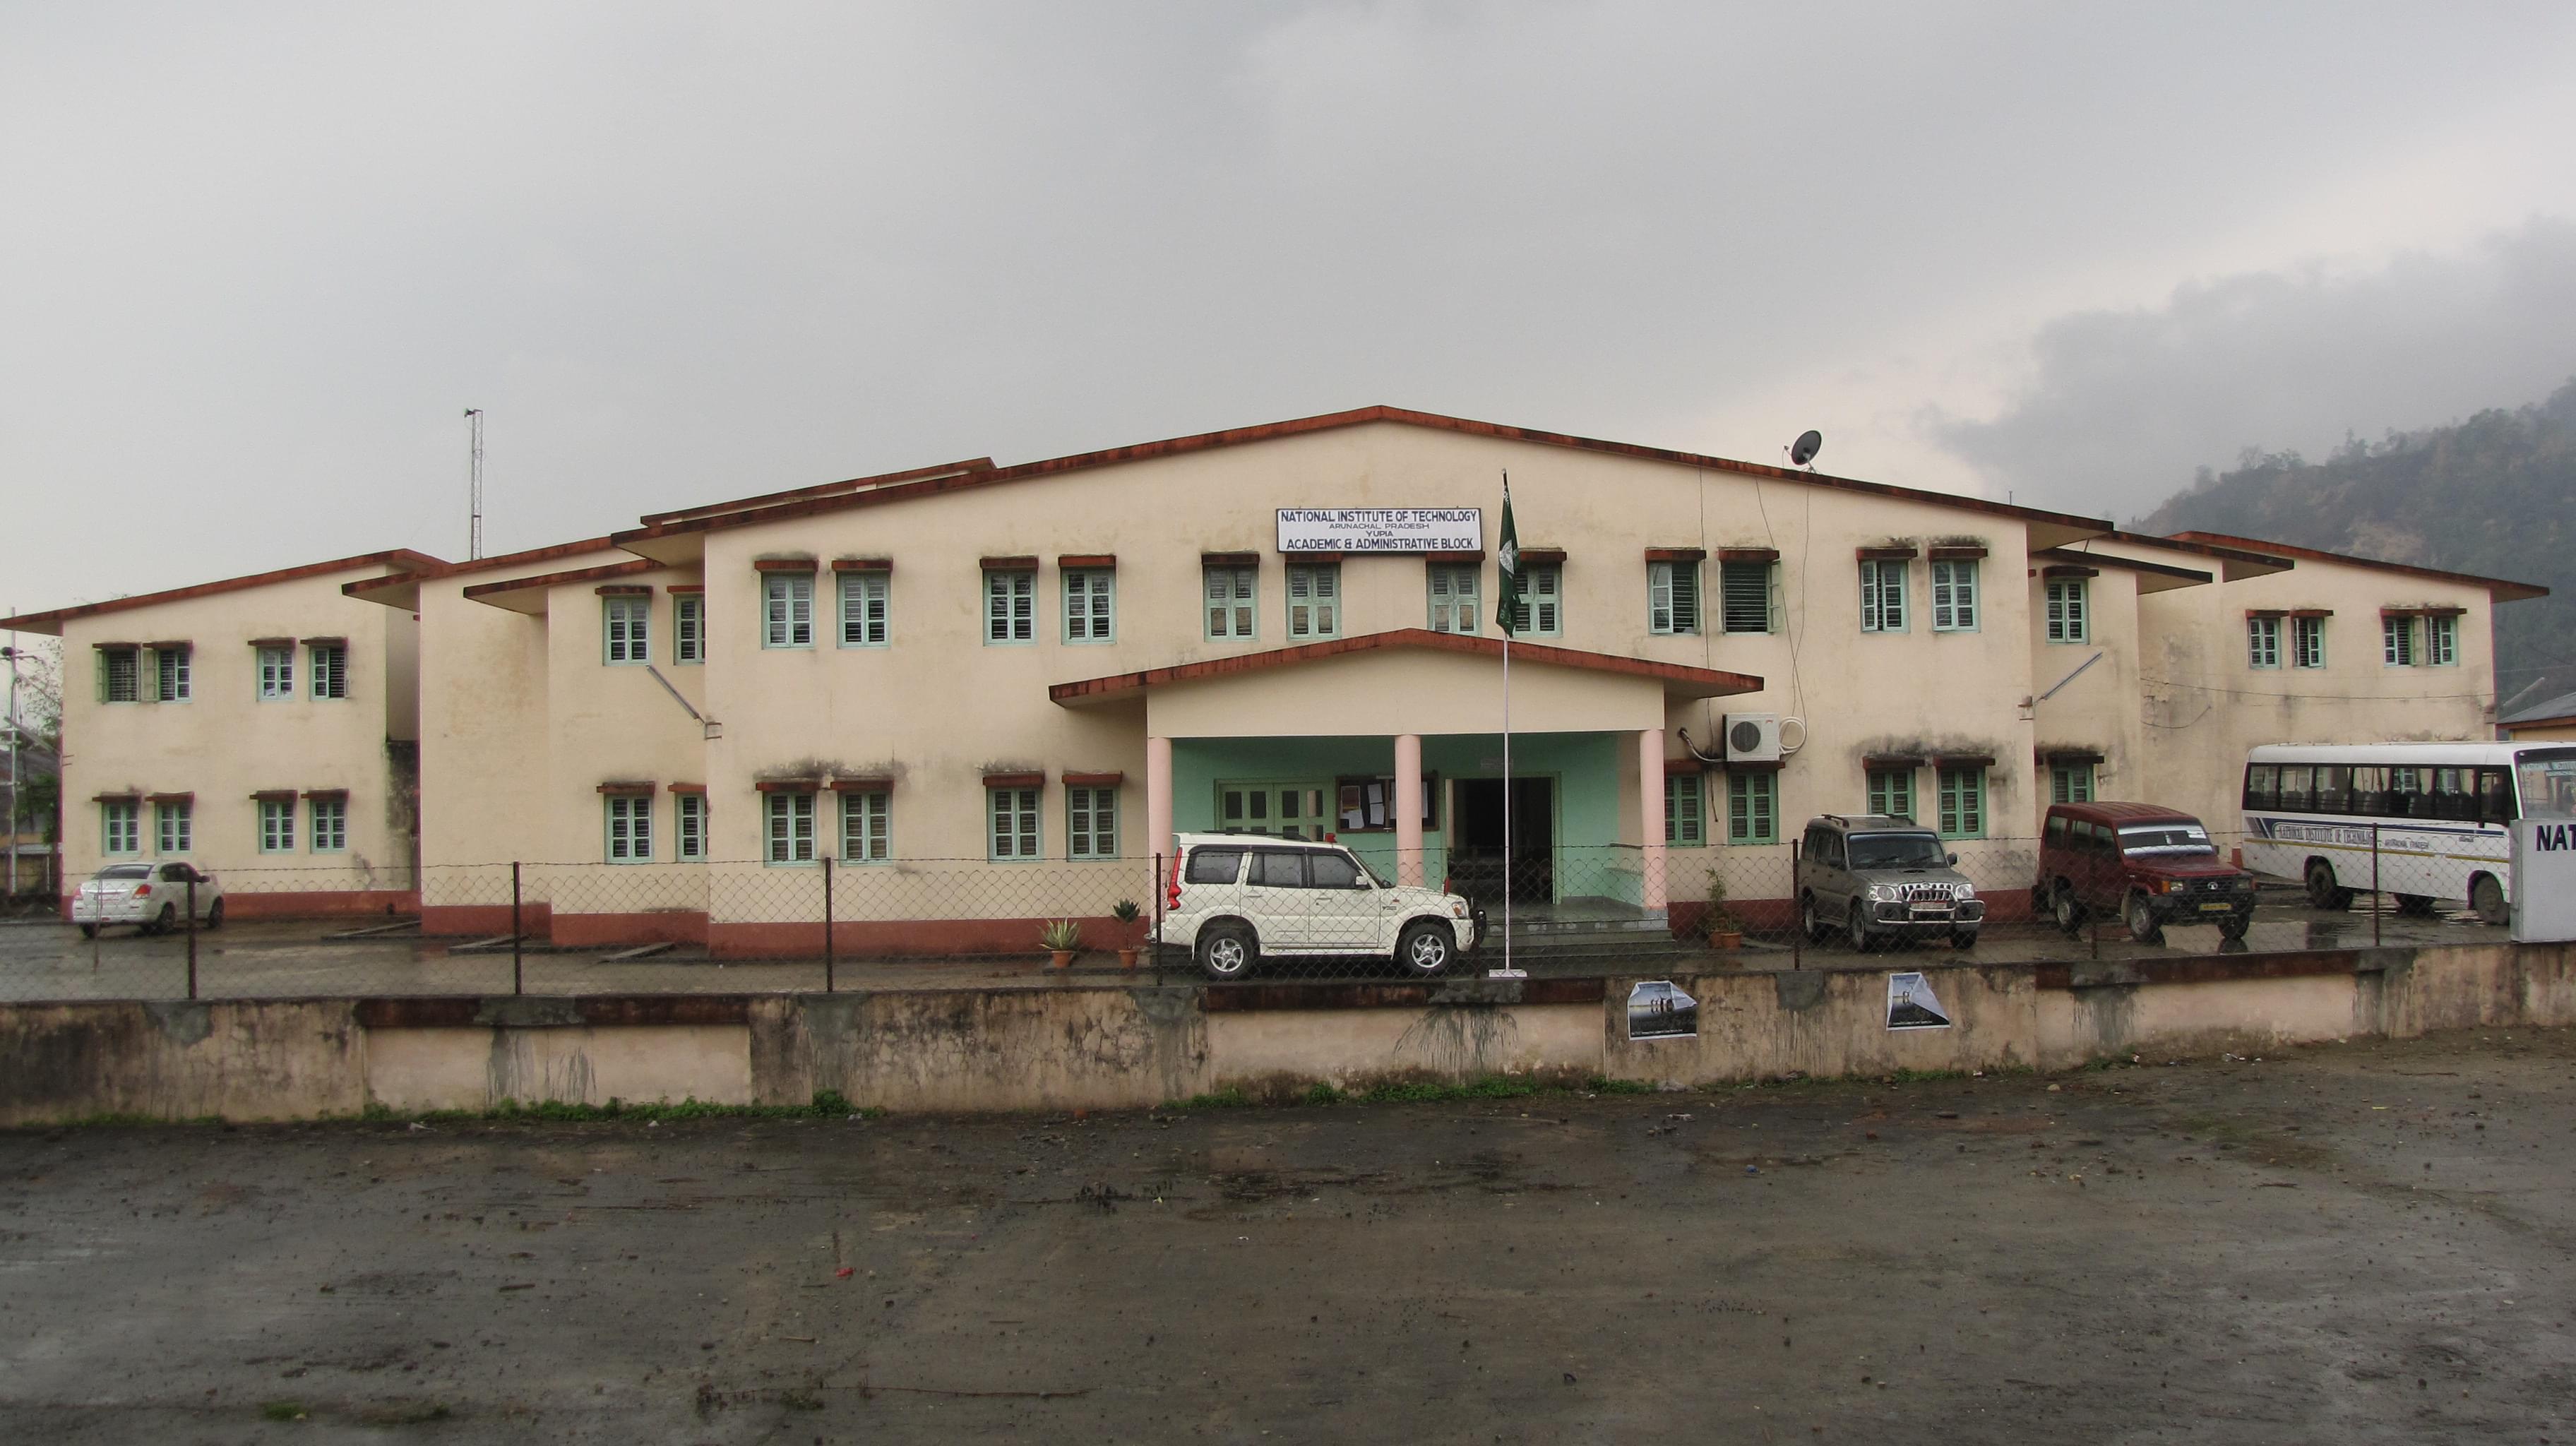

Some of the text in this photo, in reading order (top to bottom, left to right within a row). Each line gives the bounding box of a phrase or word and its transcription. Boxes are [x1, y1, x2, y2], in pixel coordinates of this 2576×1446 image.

[1281, 510, 1477, 522] NATIONAL INSTITUTE OF TECHNOLOGY
[1287, 537, 1474, 550] ACADEMIC & ADMINISTRATIVE BLOCK
[2536, 824, 2576, 851] NAT
